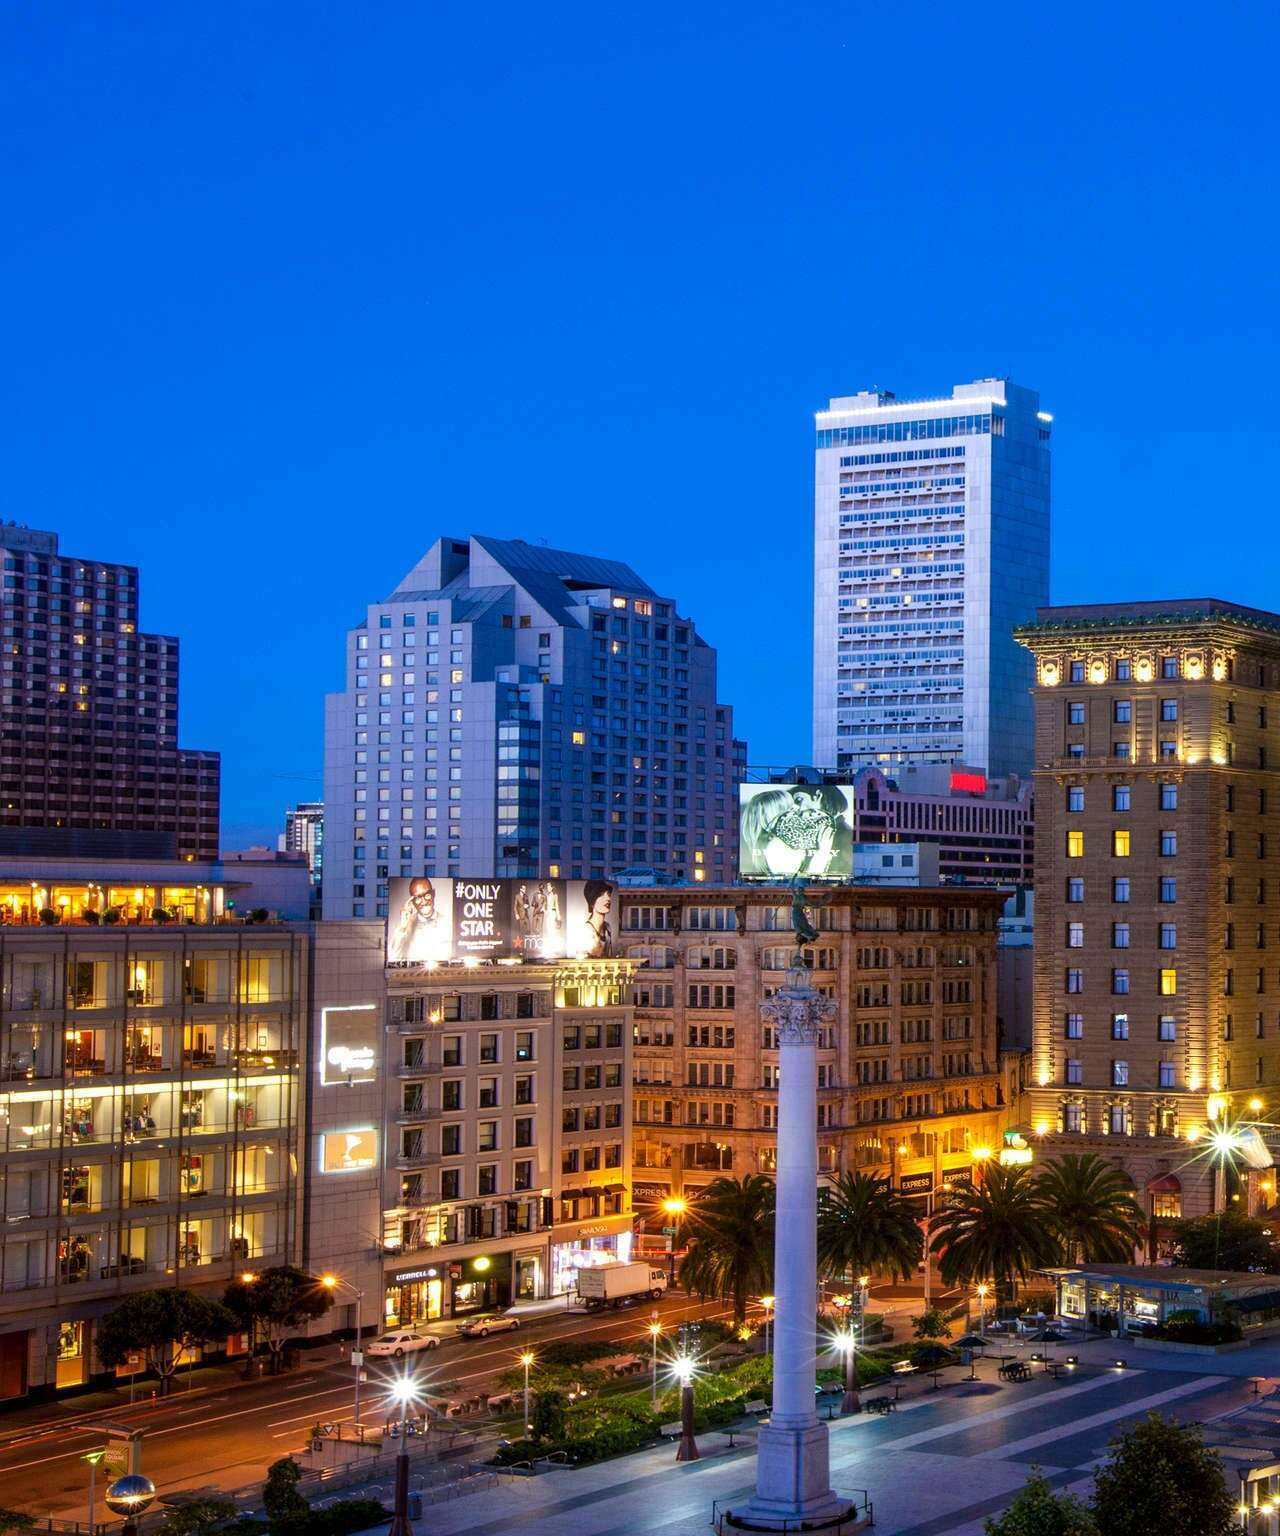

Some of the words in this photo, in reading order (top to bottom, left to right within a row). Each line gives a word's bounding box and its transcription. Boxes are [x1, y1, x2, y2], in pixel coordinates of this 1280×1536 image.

[456, 882, 500, 900] #ONLY
[463, 903, 493, 918] ONE
[902, 1179, 930, 1189] EXPRESS
